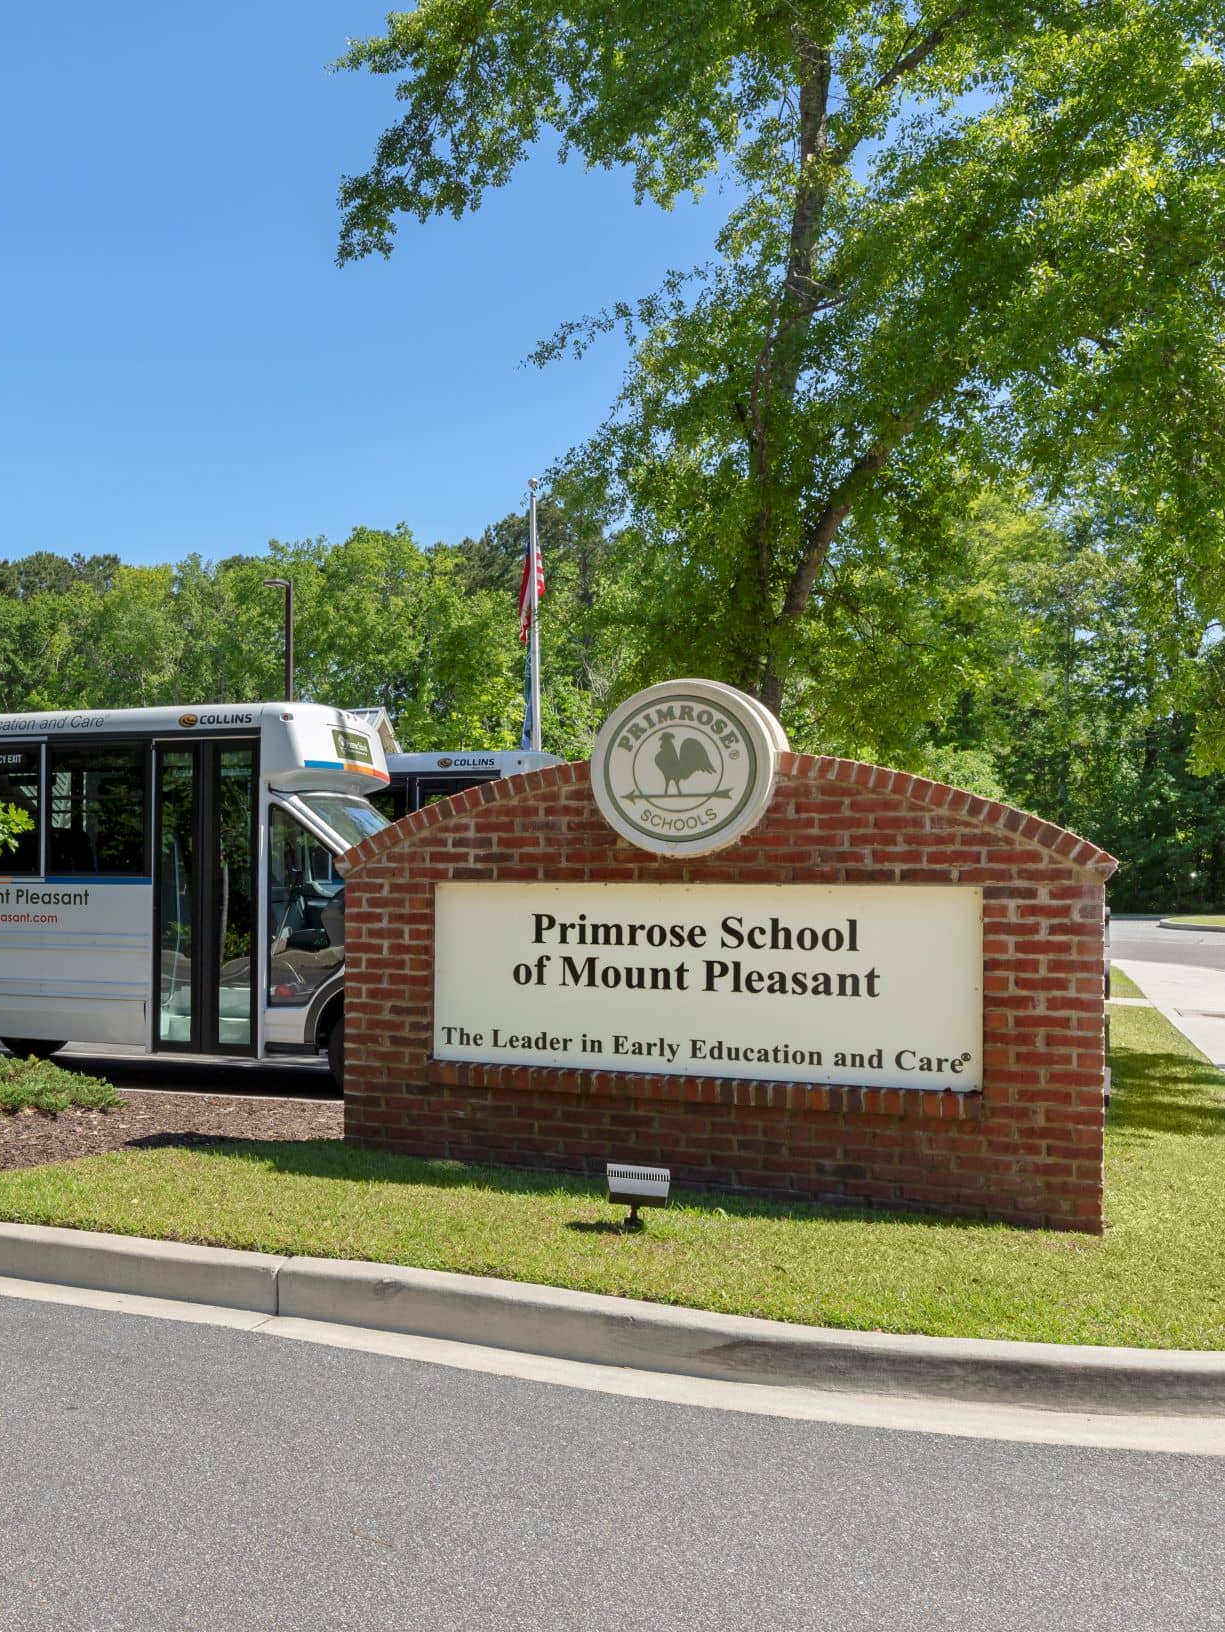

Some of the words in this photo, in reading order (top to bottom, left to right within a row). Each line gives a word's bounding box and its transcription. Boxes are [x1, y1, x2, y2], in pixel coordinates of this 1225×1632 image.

[39, 715, 65, 730] and
[199, 713, 253, 725] COLLINS
[7, 754, 23, 763] EXIT
[453, 758, 495, 767] COLLINS
[639, 807, 718, 832] SCHOOLS
[16, 889, 90, 906] Pleasant
[531, 913, 707, 948] Primrose
[721, 916, 860, 951] School
[513, 955, 551, 986] of
[559, 956, 689, 990] Mount
[702, 960, 881, 997] Pleasant
[441, 1026, 484, 1047] The
[491, 1029, 573, 1051] Leader
[581, 1033, 603, 1053] in
[612, 1035, 680, 1063] Early
[689, 1039, 823, 1066] Education
[833, 1049, 883, 1069] and
